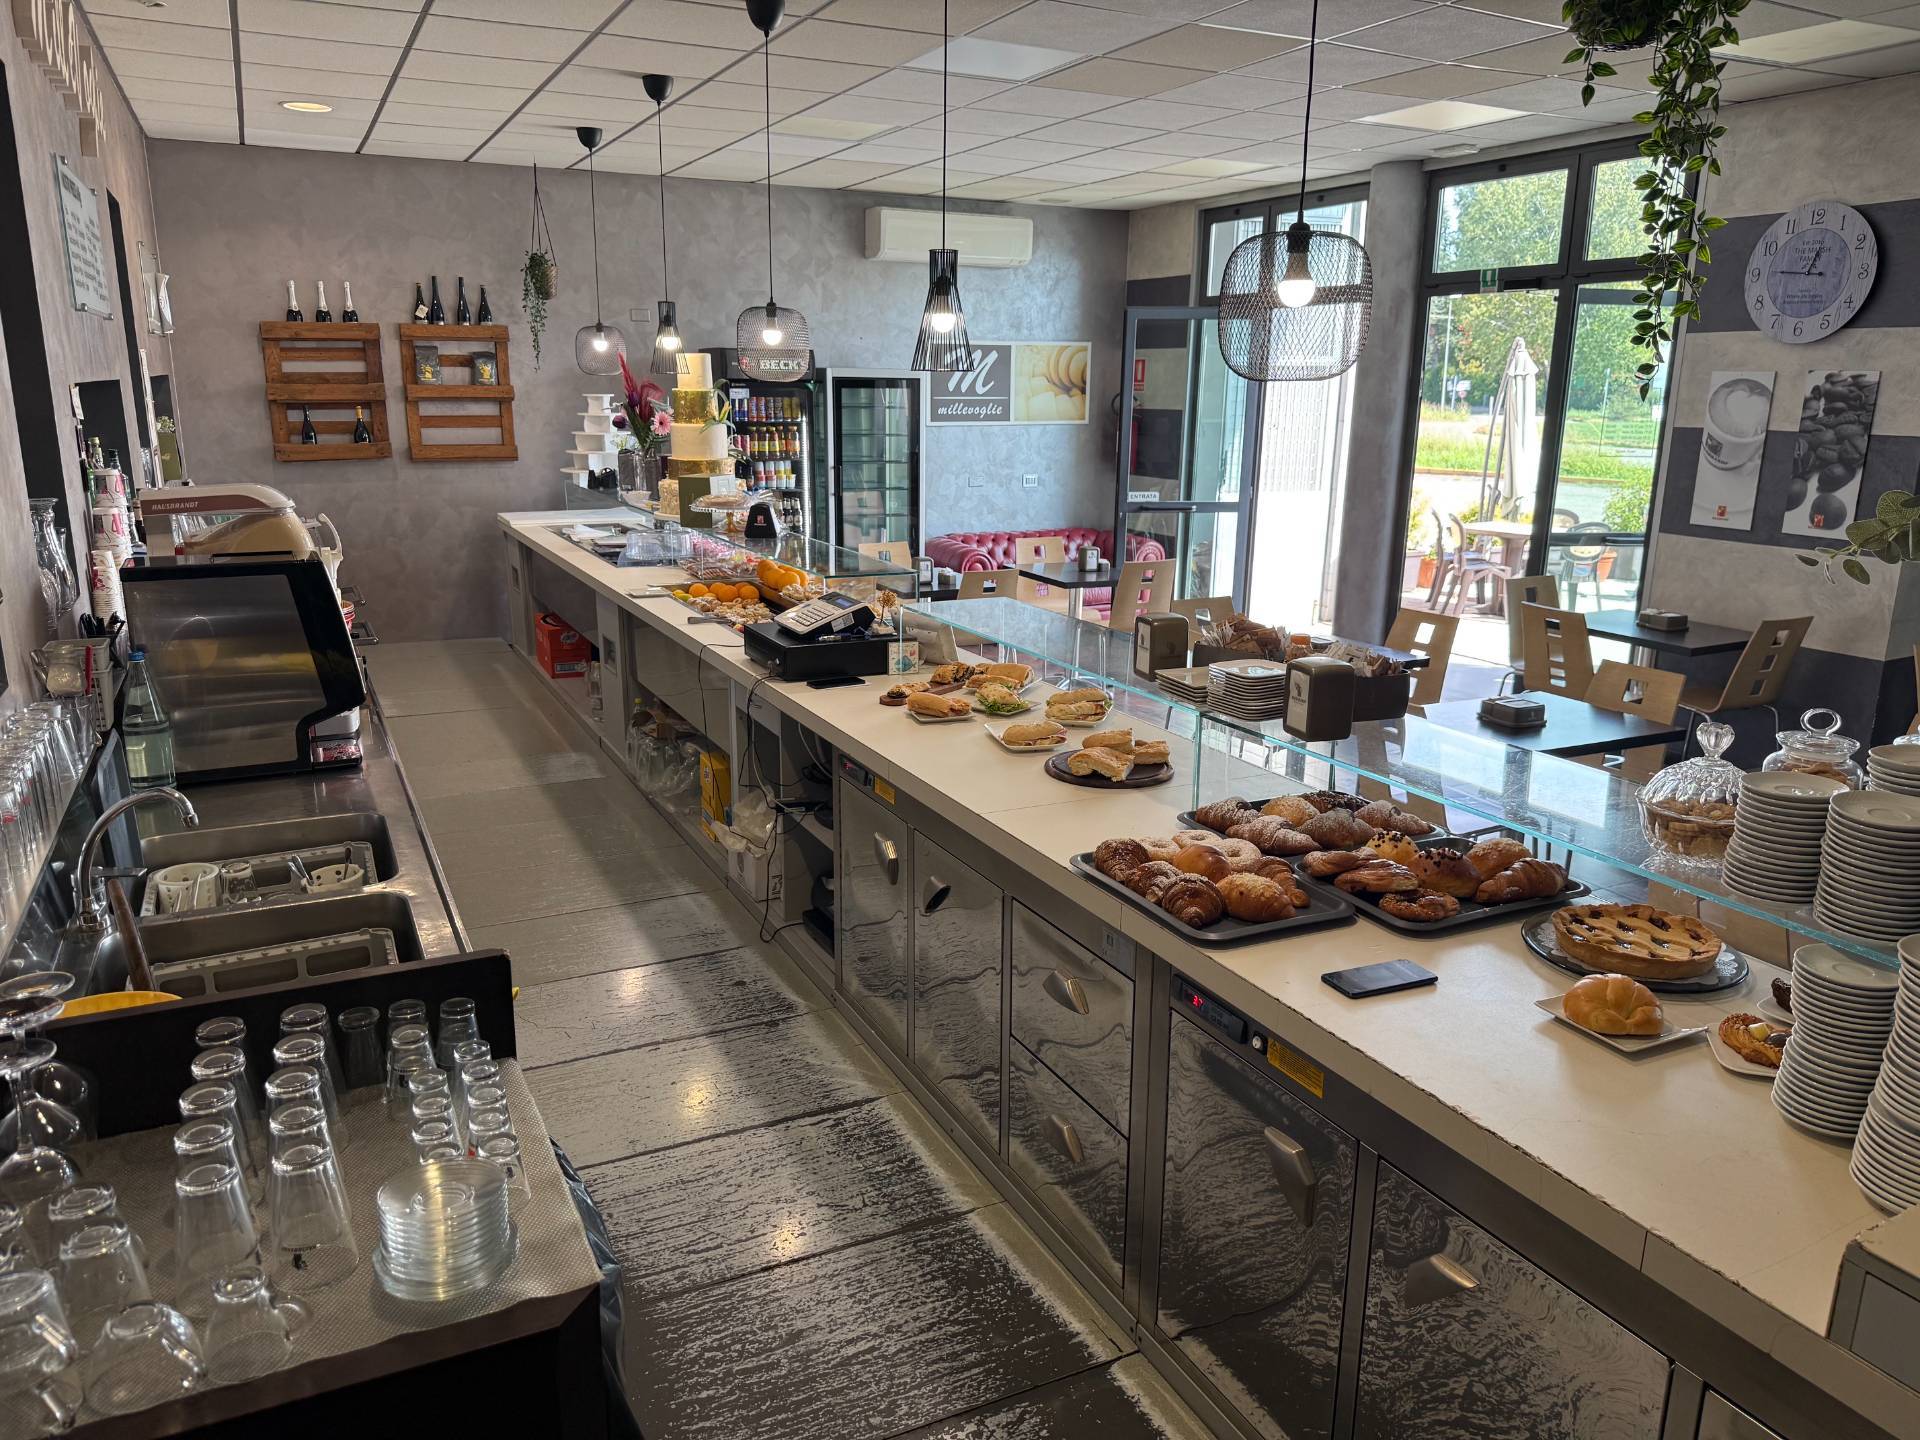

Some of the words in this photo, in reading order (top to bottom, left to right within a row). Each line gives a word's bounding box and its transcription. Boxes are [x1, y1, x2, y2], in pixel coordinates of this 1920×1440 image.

[1810, 208, 1826, 225] 12
[1840, 214, 1847, 230] 1
[1785, 219, 1797, 234] 11
[1763, 240, 1778, 256] 10
[1855, 233, 1866, 250] 2
[1751, 267, 1760, 283] 9
[1858, 262, 1870, 279] 3
[1754, 295, 1764, 310] 8
[1843, 294, 1854, 309] 4
[1770, 314, 1781, 329] 7
[1793, 321, 1803, 336] 6
[1820, 314, 1831, 329] 5
[938, 402, 1003, 419] millevoglie
[151, 501, 199, 510] HAUSBRANDT
